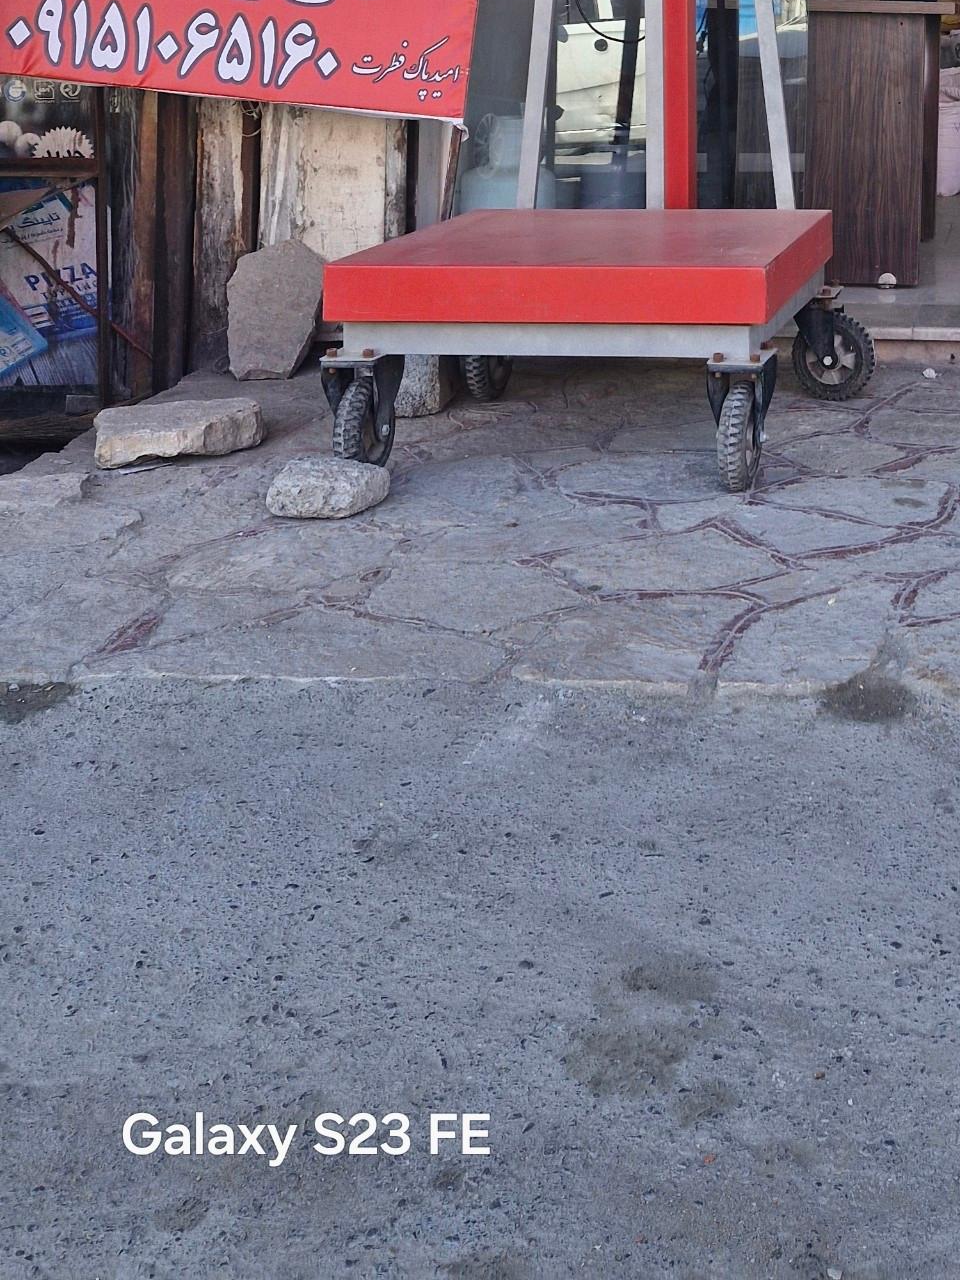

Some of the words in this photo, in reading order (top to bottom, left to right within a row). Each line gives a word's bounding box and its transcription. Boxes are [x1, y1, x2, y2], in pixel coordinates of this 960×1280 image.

[352, 40, 408, 83] فطرت
[403, 35, 450, 100] پاک
[427, 65, 460, 98] امید
